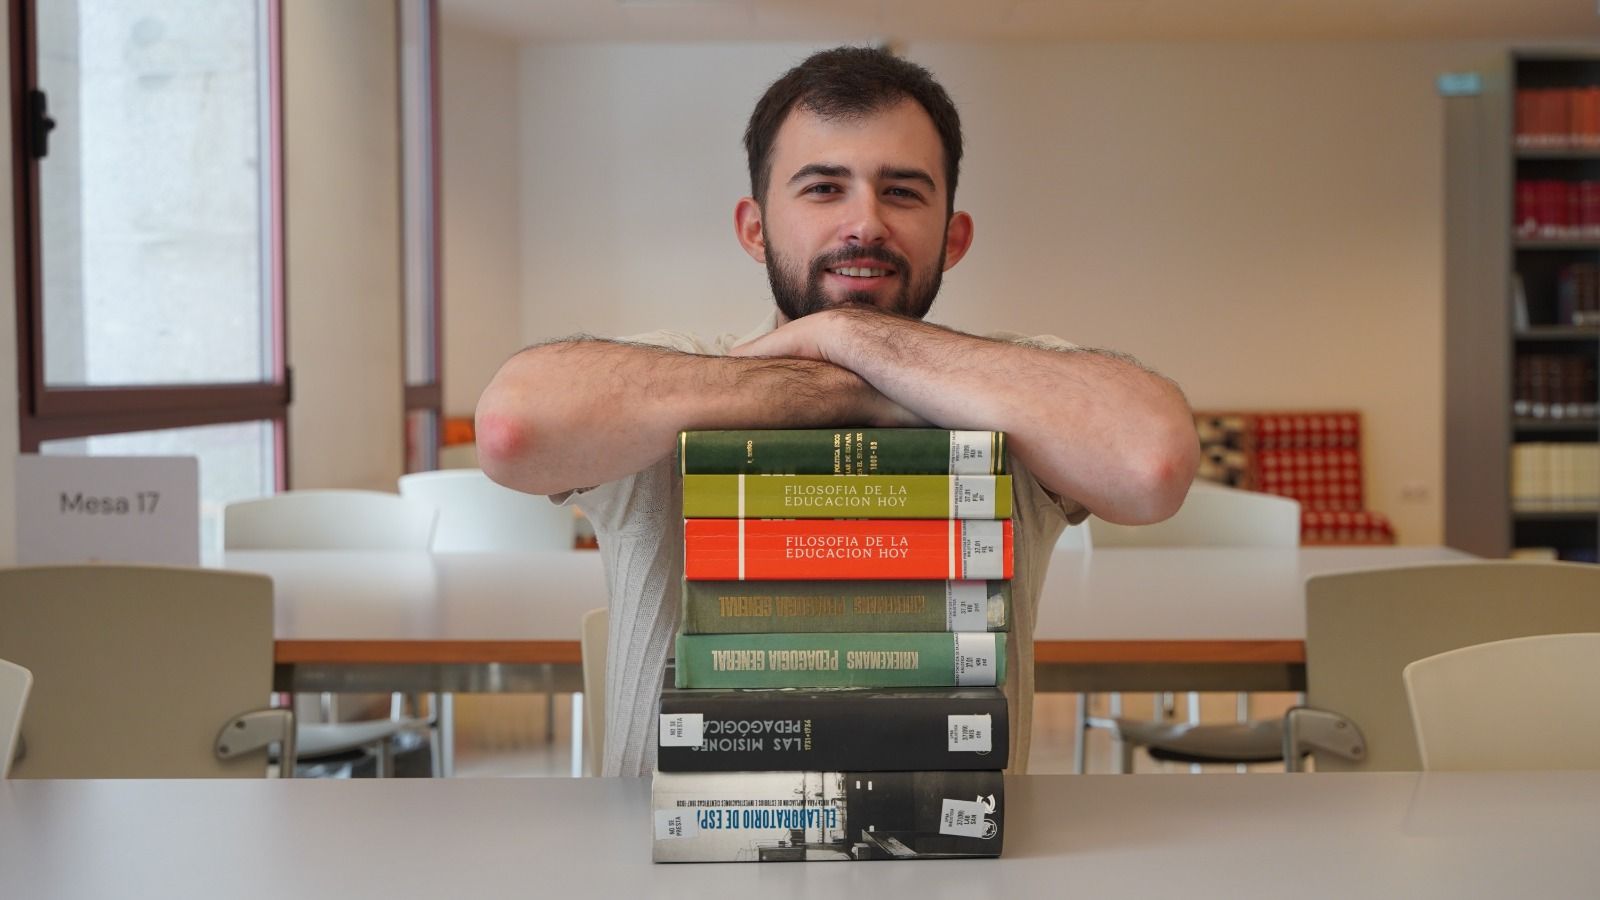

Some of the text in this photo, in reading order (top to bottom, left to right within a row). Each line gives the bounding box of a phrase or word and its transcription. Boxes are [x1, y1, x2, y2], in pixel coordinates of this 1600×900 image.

[785, 486, 907, 495] FILOSOFIA DE LA
[60, 490, 160, 515] Mesa 17
[785, 496, 907, 506] EDUCACION HOY
[786, 536, 909, 546] FILOSOFIA DE LA
[786, 548, 909, 559] EDUCACION HOY
[712, 650, 765, 671] GENERAL
[847, 651, 918, 670] KRIEKEMANS
[774, 738, 800, 751] LAS
[726, 810, 739, 829] DE
[744, 809, 820, 829] LABORATORIO
[823, 809, 836, 828] EL
